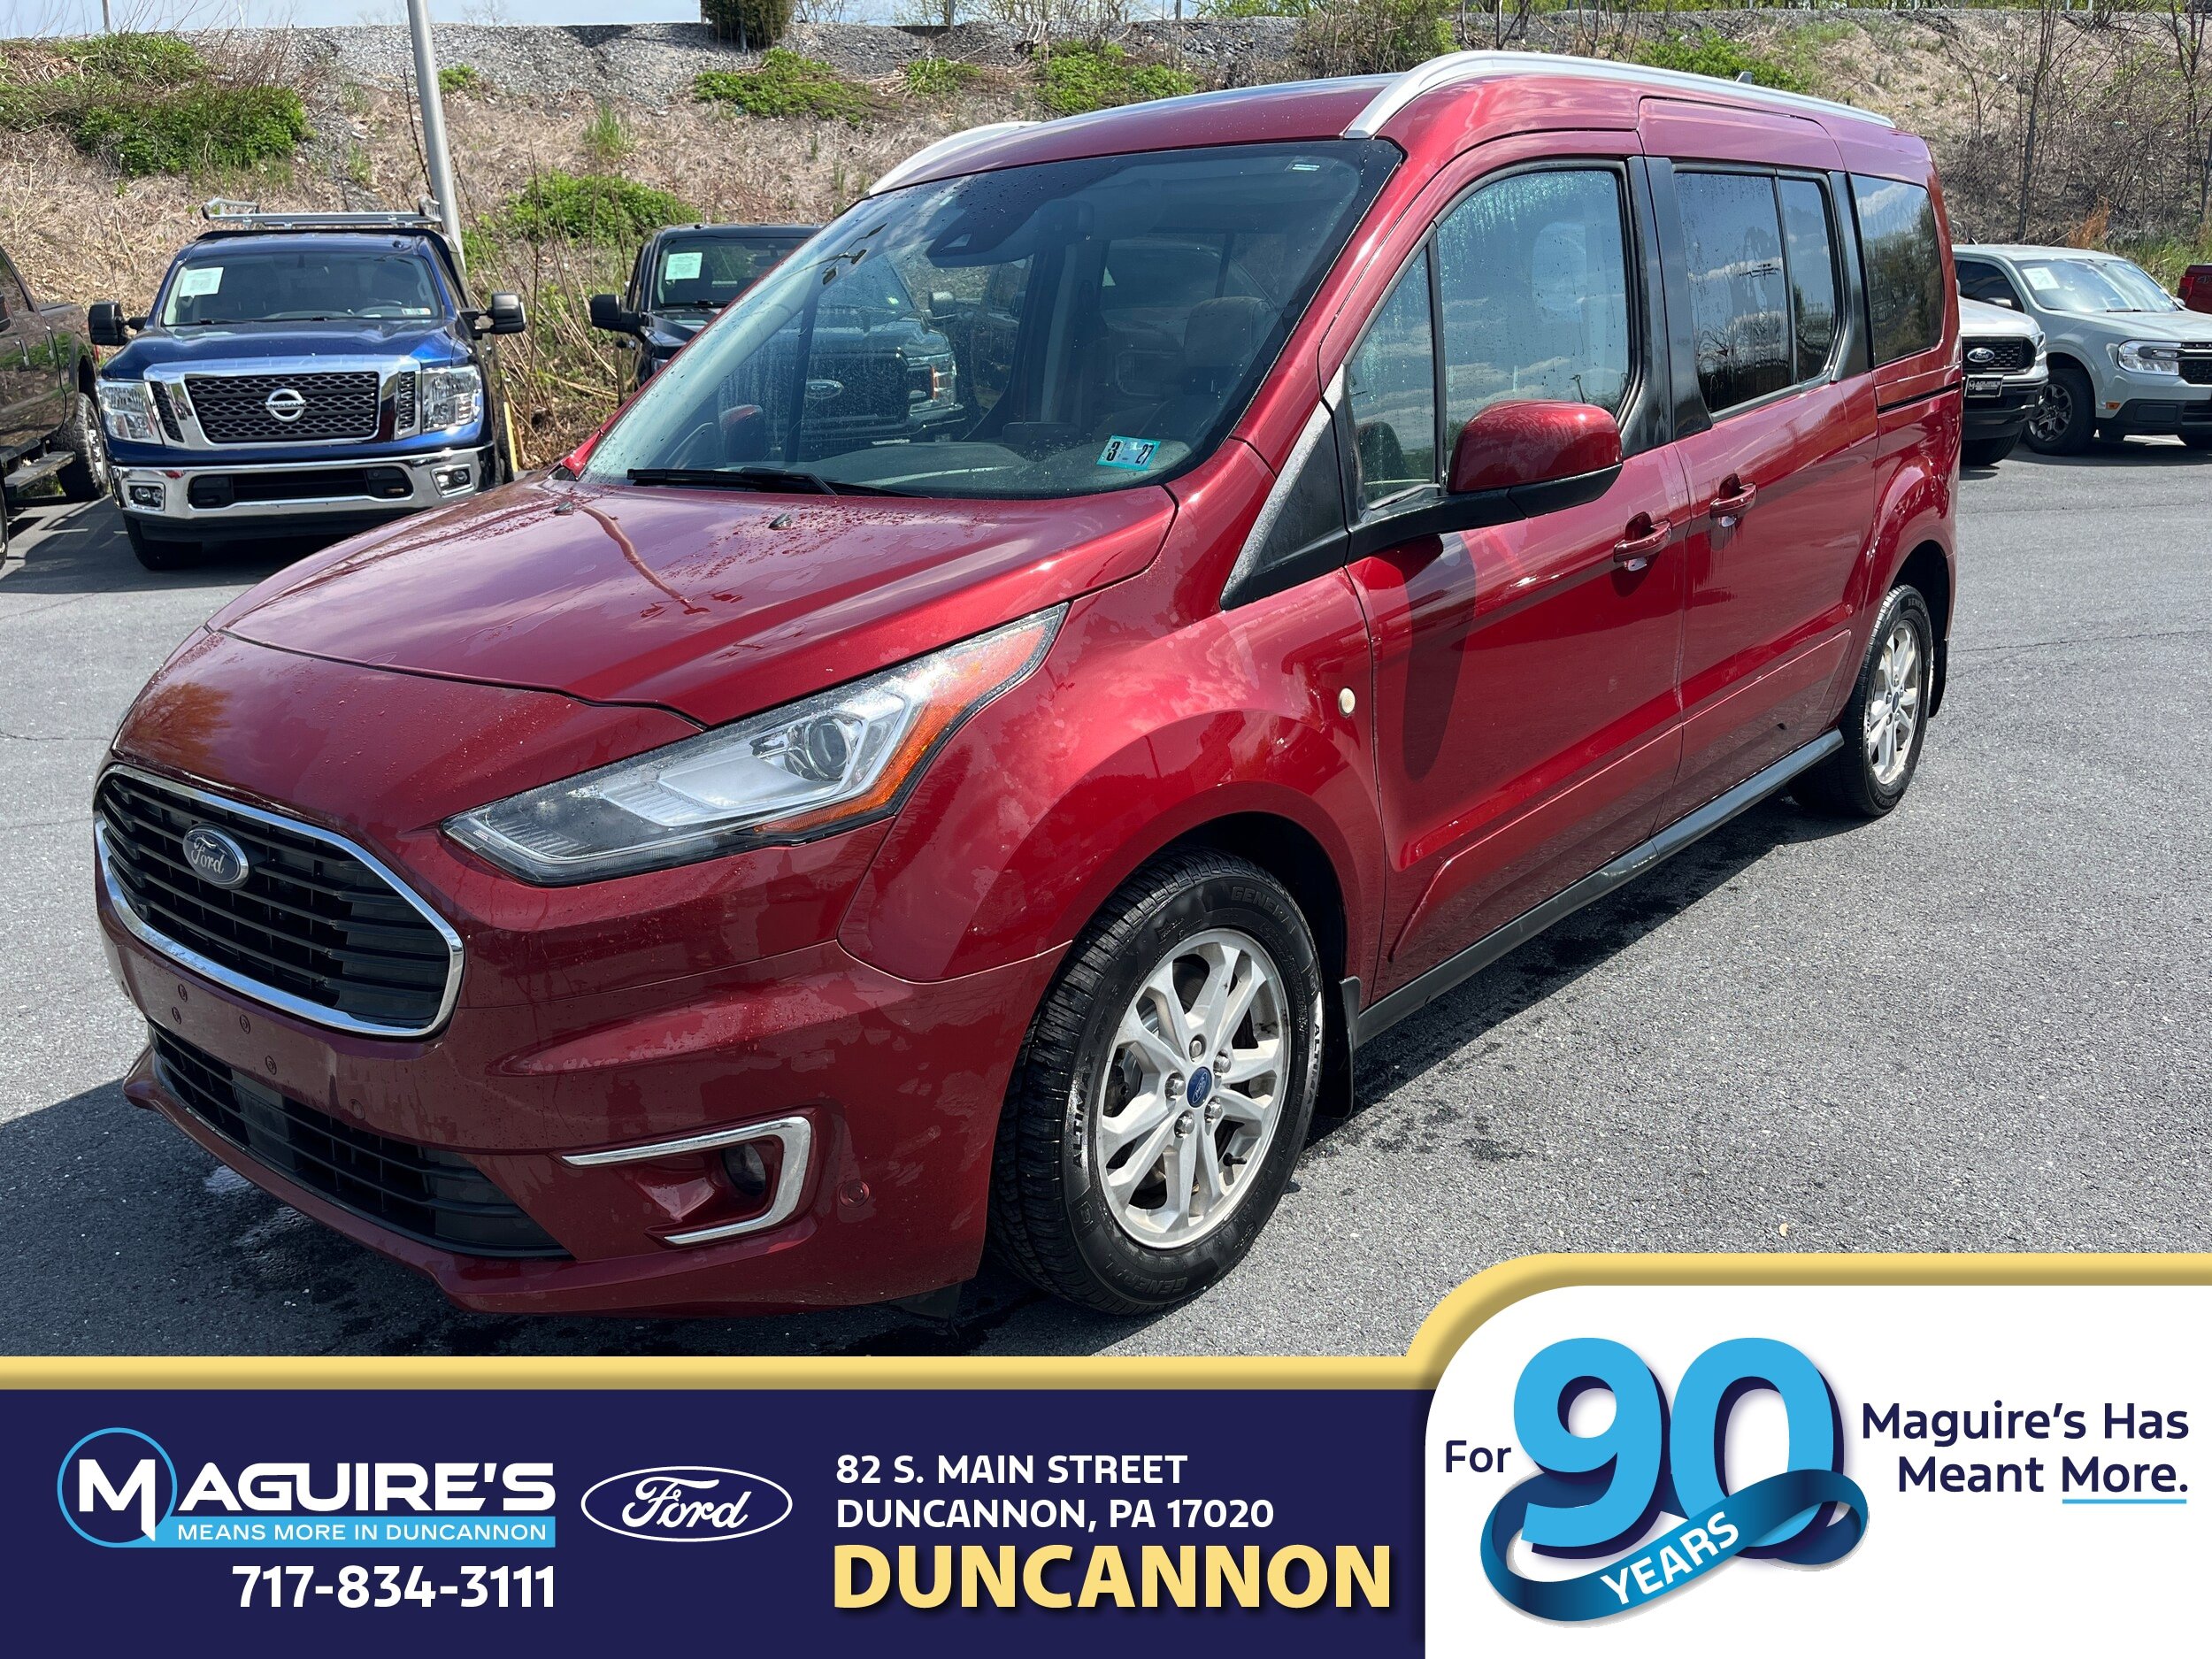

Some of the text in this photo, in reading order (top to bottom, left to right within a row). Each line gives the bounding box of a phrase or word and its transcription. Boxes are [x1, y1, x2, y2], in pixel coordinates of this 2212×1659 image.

[1106, 441, 1121, 462] 3
[1135, 443, 1155, 465] 27
[190, 835, 226, 874] Ford
